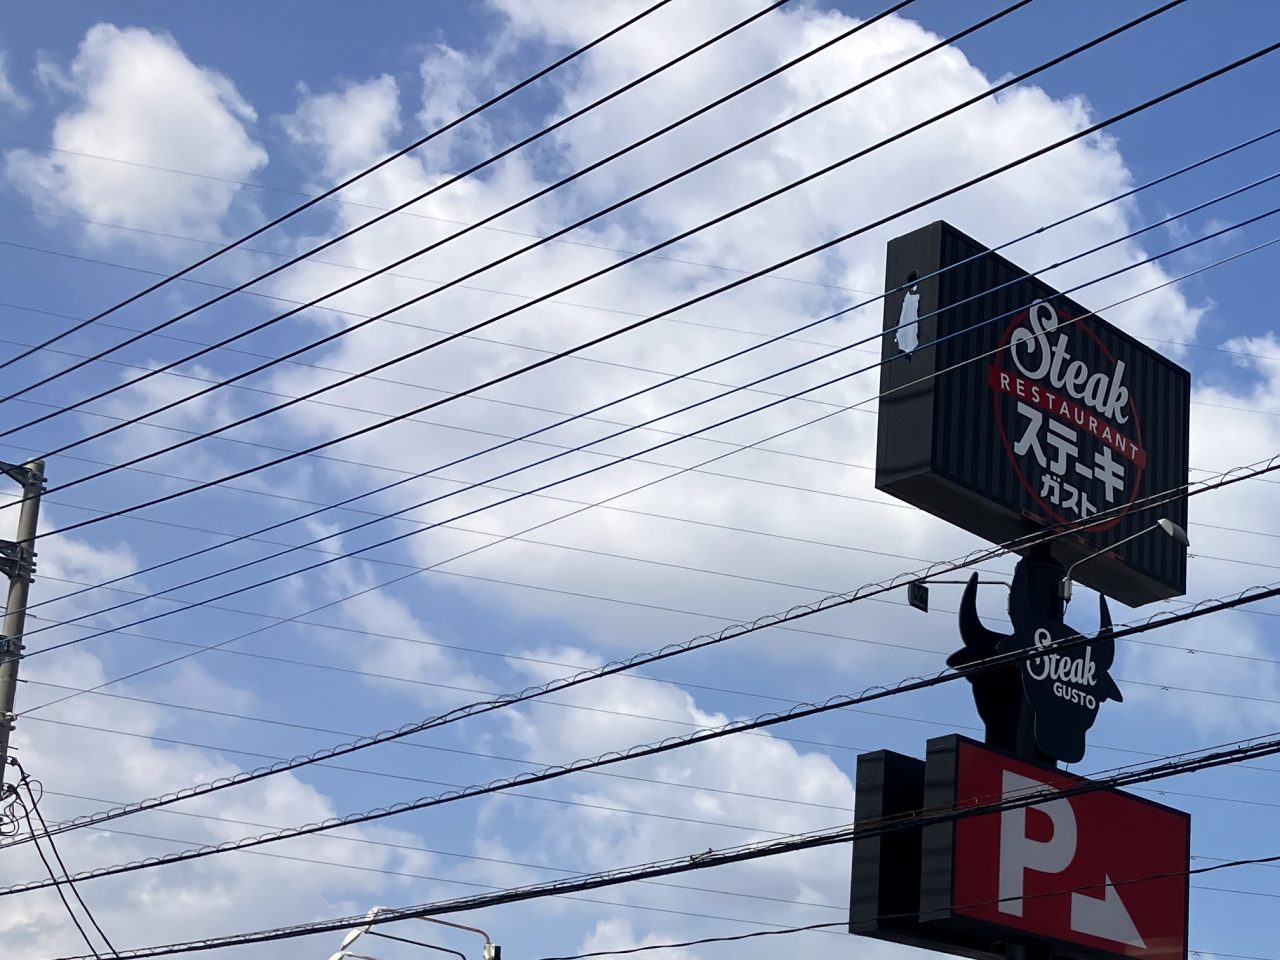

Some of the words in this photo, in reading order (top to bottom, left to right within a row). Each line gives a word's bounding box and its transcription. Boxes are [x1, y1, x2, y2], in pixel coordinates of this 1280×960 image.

[1010, 298, 1129, 425] Steak
[1000, 373, 1139, 461] RESTAURANT
[1013, 401, 1126, 504] ステーキ
[1040, 473, 1098, 519] ガスト
[1026, 627, 1098, 687] Steak
[1053, 682, 1096, 710] GUSTO
[997, 769, 1078, 919] P
